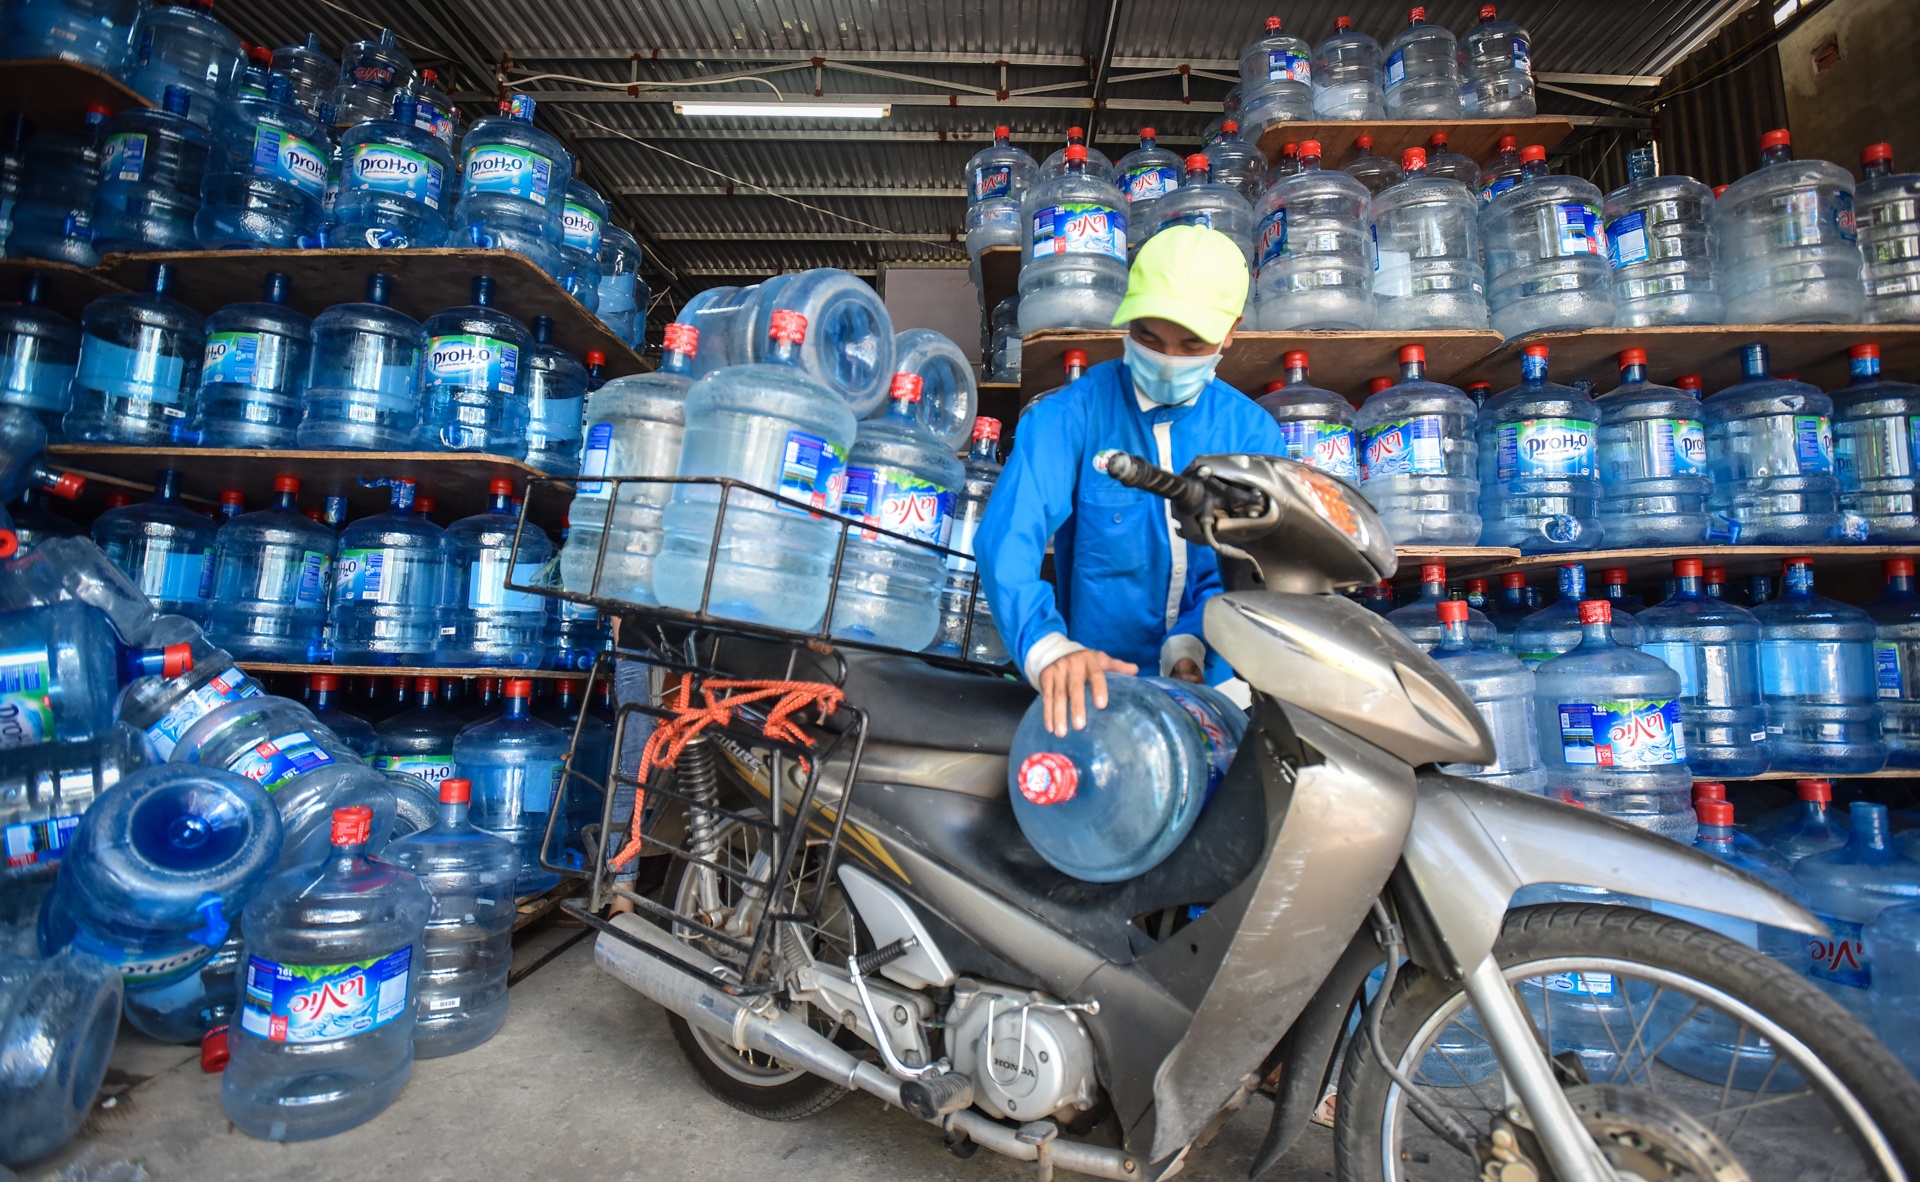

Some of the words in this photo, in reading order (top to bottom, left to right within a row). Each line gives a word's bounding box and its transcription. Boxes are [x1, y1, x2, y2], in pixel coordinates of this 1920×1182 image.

[1067, 214, 1107, 237] laVie
[1316, 435, 1351, 461] laVie
[1367, 431, 1402, 462] laVie
[884, 493, 937, 524] laVie
[1611, 712, 1665, 747] laVie
[291, 976, 366, 1021] laVie
